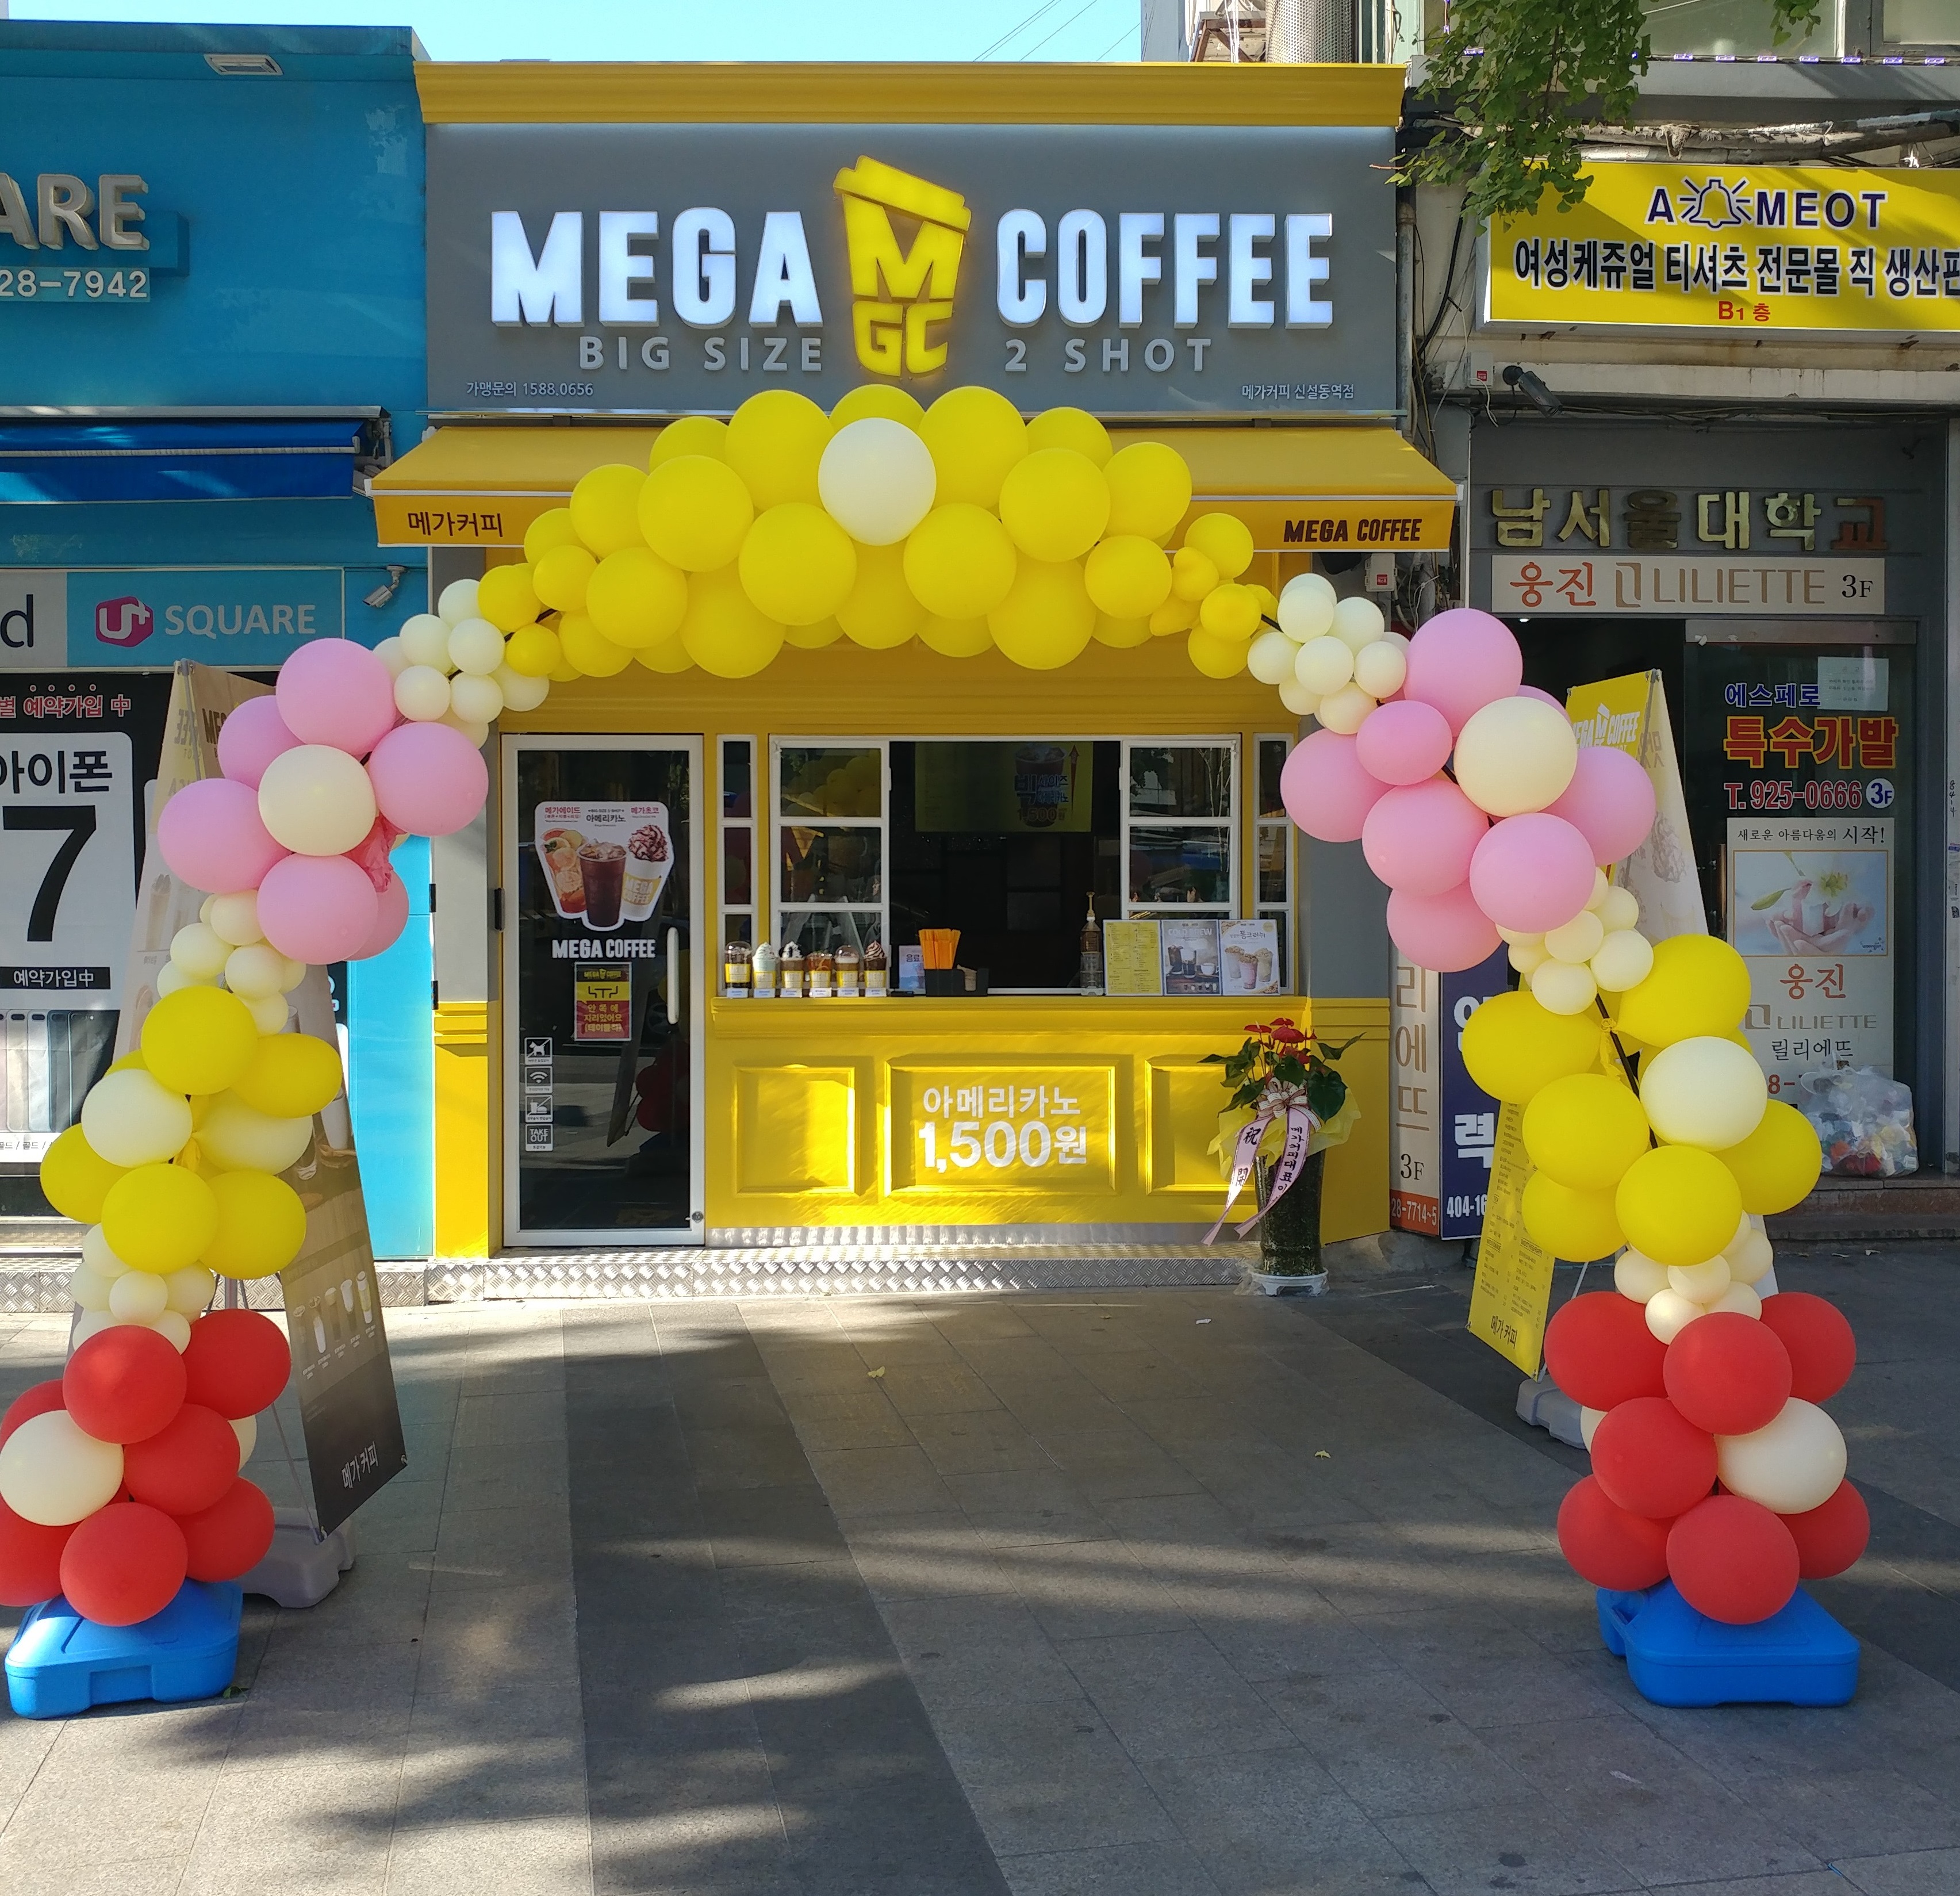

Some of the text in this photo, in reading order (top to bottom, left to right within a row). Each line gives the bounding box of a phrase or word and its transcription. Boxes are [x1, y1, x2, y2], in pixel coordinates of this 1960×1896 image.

[492, 207, 1334, 330] MEGA COFFEE
[1513, 237, 1656, 292] 여성케쥬얼
[1664, 240, 1750, 295] 티셔츠
[1756, 243, 1841, 297] 전문몰
[1850, 246, 1877, 299] 직
[1753, 302, 1771, 322] 층
[580, 336, 823, 372] BIG SIZE
[1004, 338, 1212, 373] 2 SHOT
[466, 381, 594, 398] 가맹문의 1588.0656
[1241, 383, 1355, 401] 메가커피 신설동역점
[408, 511, 503, 538] 메가커피
[1283, 518, 1422, 542] MEGA COFFEE
[1491, 488, 1890, 551] 남서울대학교
[1509, 561, 1874, 608] 웅진 LILIETTE 3F
[164, 604, 316, 639] SQUARE
[23, 694, 103, 719] 예약가입
[110, 694, 131, 718] 中
[1725, 683, 1821, 708] 에스페로
[1723, 715, 1900, 769] 특수가발
[1870, 782, 1894, 805] 3F
[544, 806, 581, 814] 메가에이드
[586, 814, 626, 823] 아메리카노
[1737, 826, 1885, 845] 새로운 아름다움의 시작!
[2, 805, 97, 942] 7
[552, 939, 656, 959] MEGA COFFEE
[1779, 963, 1846, 999] 웅진
[584, 1013, 623, 1022] 자리있어요
[1777, 1014, 1877, 1030] LILIETTE
[1771, 1038, 1854, 1061] 릴리에뜨
[923, 1085, 1081, 1119] 아메리카노
[918, 1121, 1087, 1174] 1,500원
[1400, 1154, 1425, 1181] 3F
[1490, 1314, 1518, 1350] 메가커피
[340, 1441, 380, 1489] 메가커피
